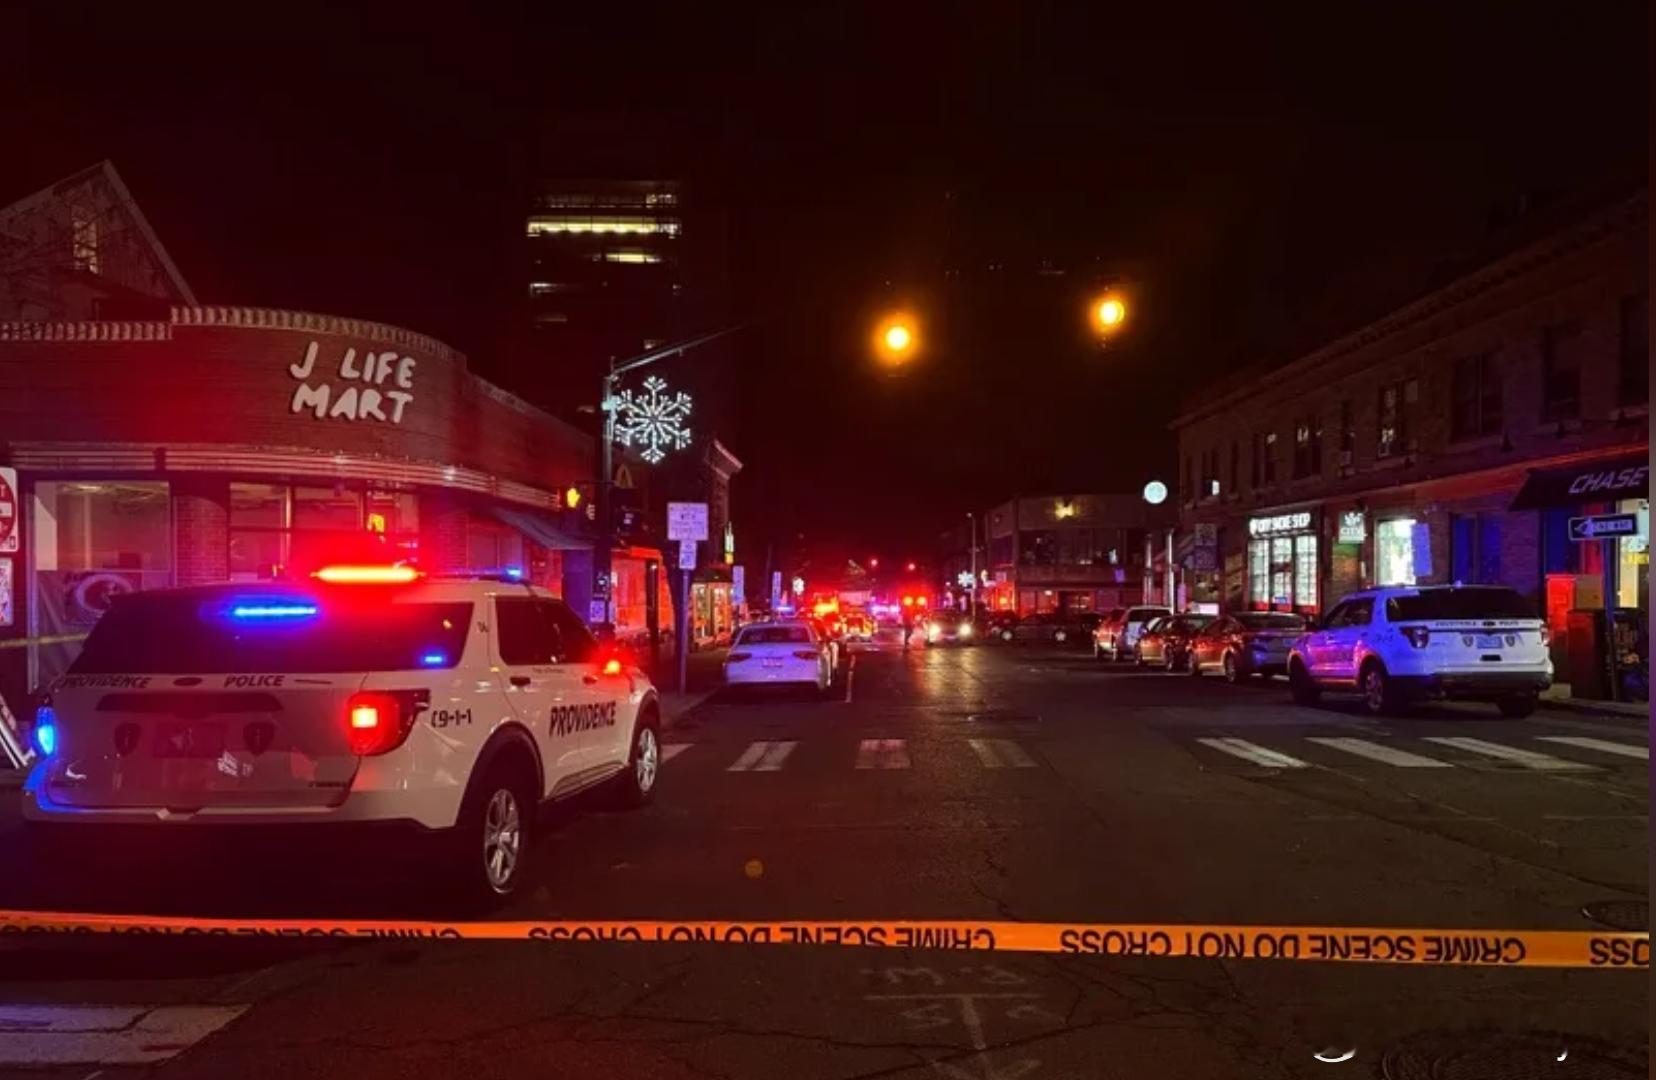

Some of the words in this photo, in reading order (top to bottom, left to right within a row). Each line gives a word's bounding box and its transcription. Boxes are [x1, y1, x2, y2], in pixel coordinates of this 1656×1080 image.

[290, 341, 319, 379] J
[340, 347, 416, 389] LIFE
[291, 383, 414, 424] MART
[1567, 465, 1649, 494] CHASE
[223, 675, 285, 688] POLICE
[549, 701, 616, 737] PROVIDENCE
[893, 927, 996, 950] CRIME
[1060, 929, 1172, 957] CROSS
[1183, 932, 1245, 958] NOT
[1254, 933, 1299, 959] DO
[1307, 934, 1416, 962] SCENE
[1422, 936, 1527, 964] CRIME
